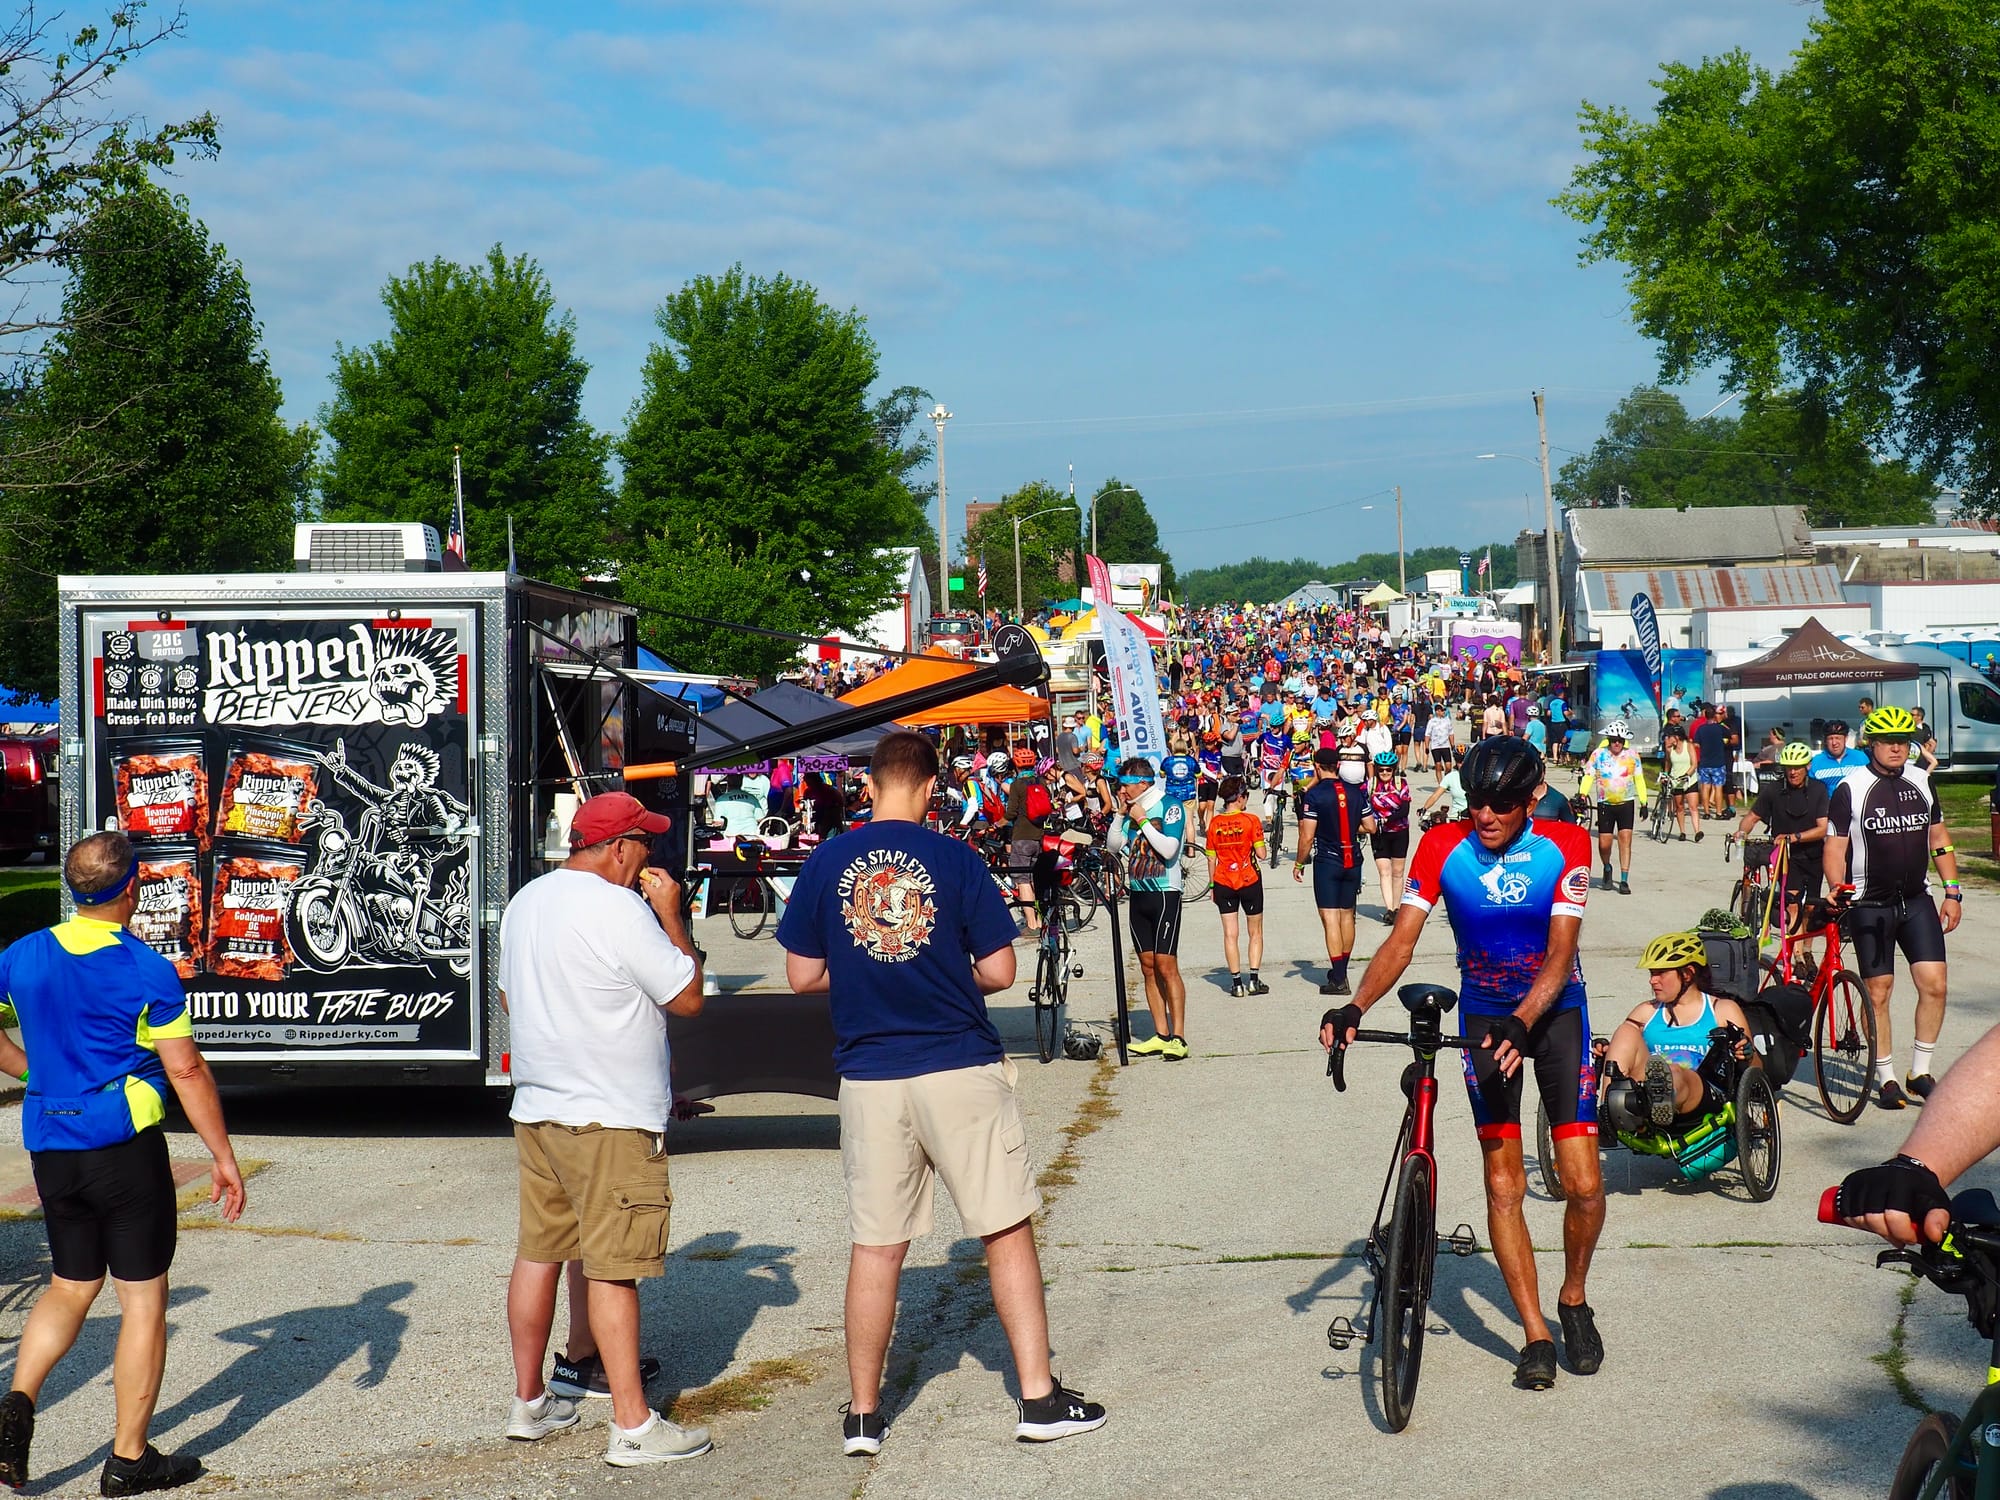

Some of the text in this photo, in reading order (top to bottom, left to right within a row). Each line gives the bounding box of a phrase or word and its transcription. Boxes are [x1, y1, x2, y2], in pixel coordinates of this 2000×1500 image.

[1450, 600, 1478, 608] LEMONADE
[1631, 598, 1661, 675] RAGBRAI
[206, 624, 374, 695] Ripped
[1776, 670, 1885, 681] FAIR TRADE ORGANIC COFFEE
[106, 697, 197, 710] Made With 100%
[213, 684, 371, 724] BEEF JERKY
[107, 712, 197, 726] Grass-fed Beef
[798, 757, 848, 772] PROJECT
[131, 771, 179, 795] Ripped
[241, 774, 289, 793] Ripped
[729, 790, 749, 802] STAFF
[144, 807, 183, 817] Heavenly
[244, 805, 284, 820] Pineapple
[148, 816, 180, 826] Hellfire
[245, 815, 280, 828] Express
[1864, 812, 1929, 830] GUINNESS
[837, 849, 937, 897] CHRIS STAPLETON
[139, 877, 172, 899] pped
[230, 878, 277, 896] Ripped
[234, 911, 276, 924] Godfather
[144, 922, 170, 933] Peppa
[248, 922, 259, 931] OG
[867, 947, 895, 963] WHITE
[185, 988, 455, 1023] INTO YOUR TASTE BUDS
[193, 1029, 399, 1041] ippedJerkyCo RippedJerky.Com
[554, 1365, 579, 1381] HOKA
